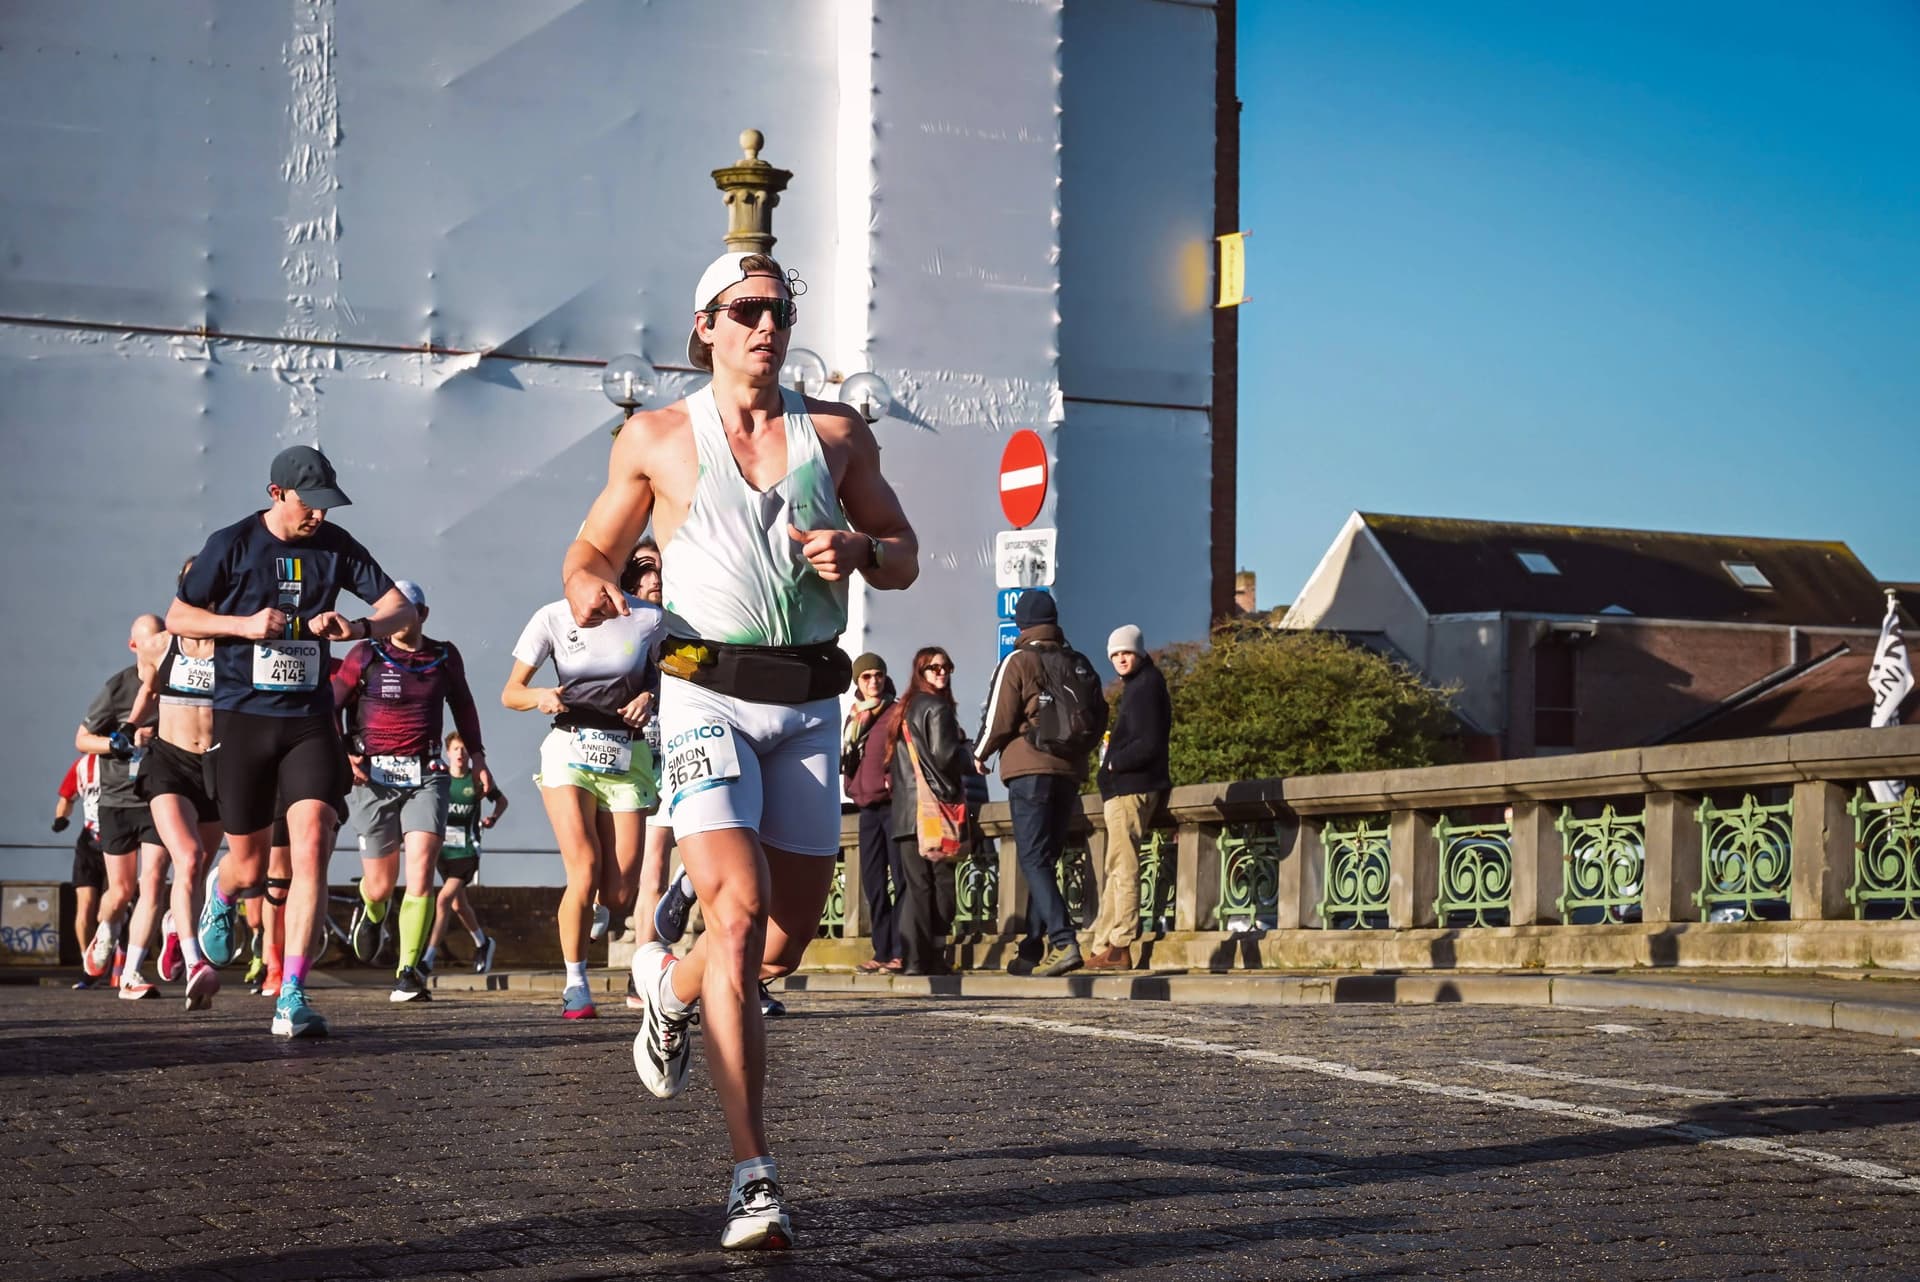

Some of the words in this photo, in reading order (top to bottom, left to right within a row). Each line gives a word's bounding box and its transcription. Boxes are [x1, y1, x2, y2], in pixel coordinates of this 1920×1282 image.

[1004, 591, 1024, 615] 10
[277, 646, 317, 656] SOFICO
[193, 658, 214, 668] SOF
[273, 660, 306, 669] ANTON
[187, 674, 210, 689] 576
[271, 668, 306, 682] 4145
[591, 731, 629, 745] SOFICO
[667, 725, 725, 754] SOFICO
[581, 743, 622, 755] ANNELORE
[585, 750, 617, 767] 1482
[668, 746, 706, 773] SIMON
[669, 757, 713, 794] 3621
